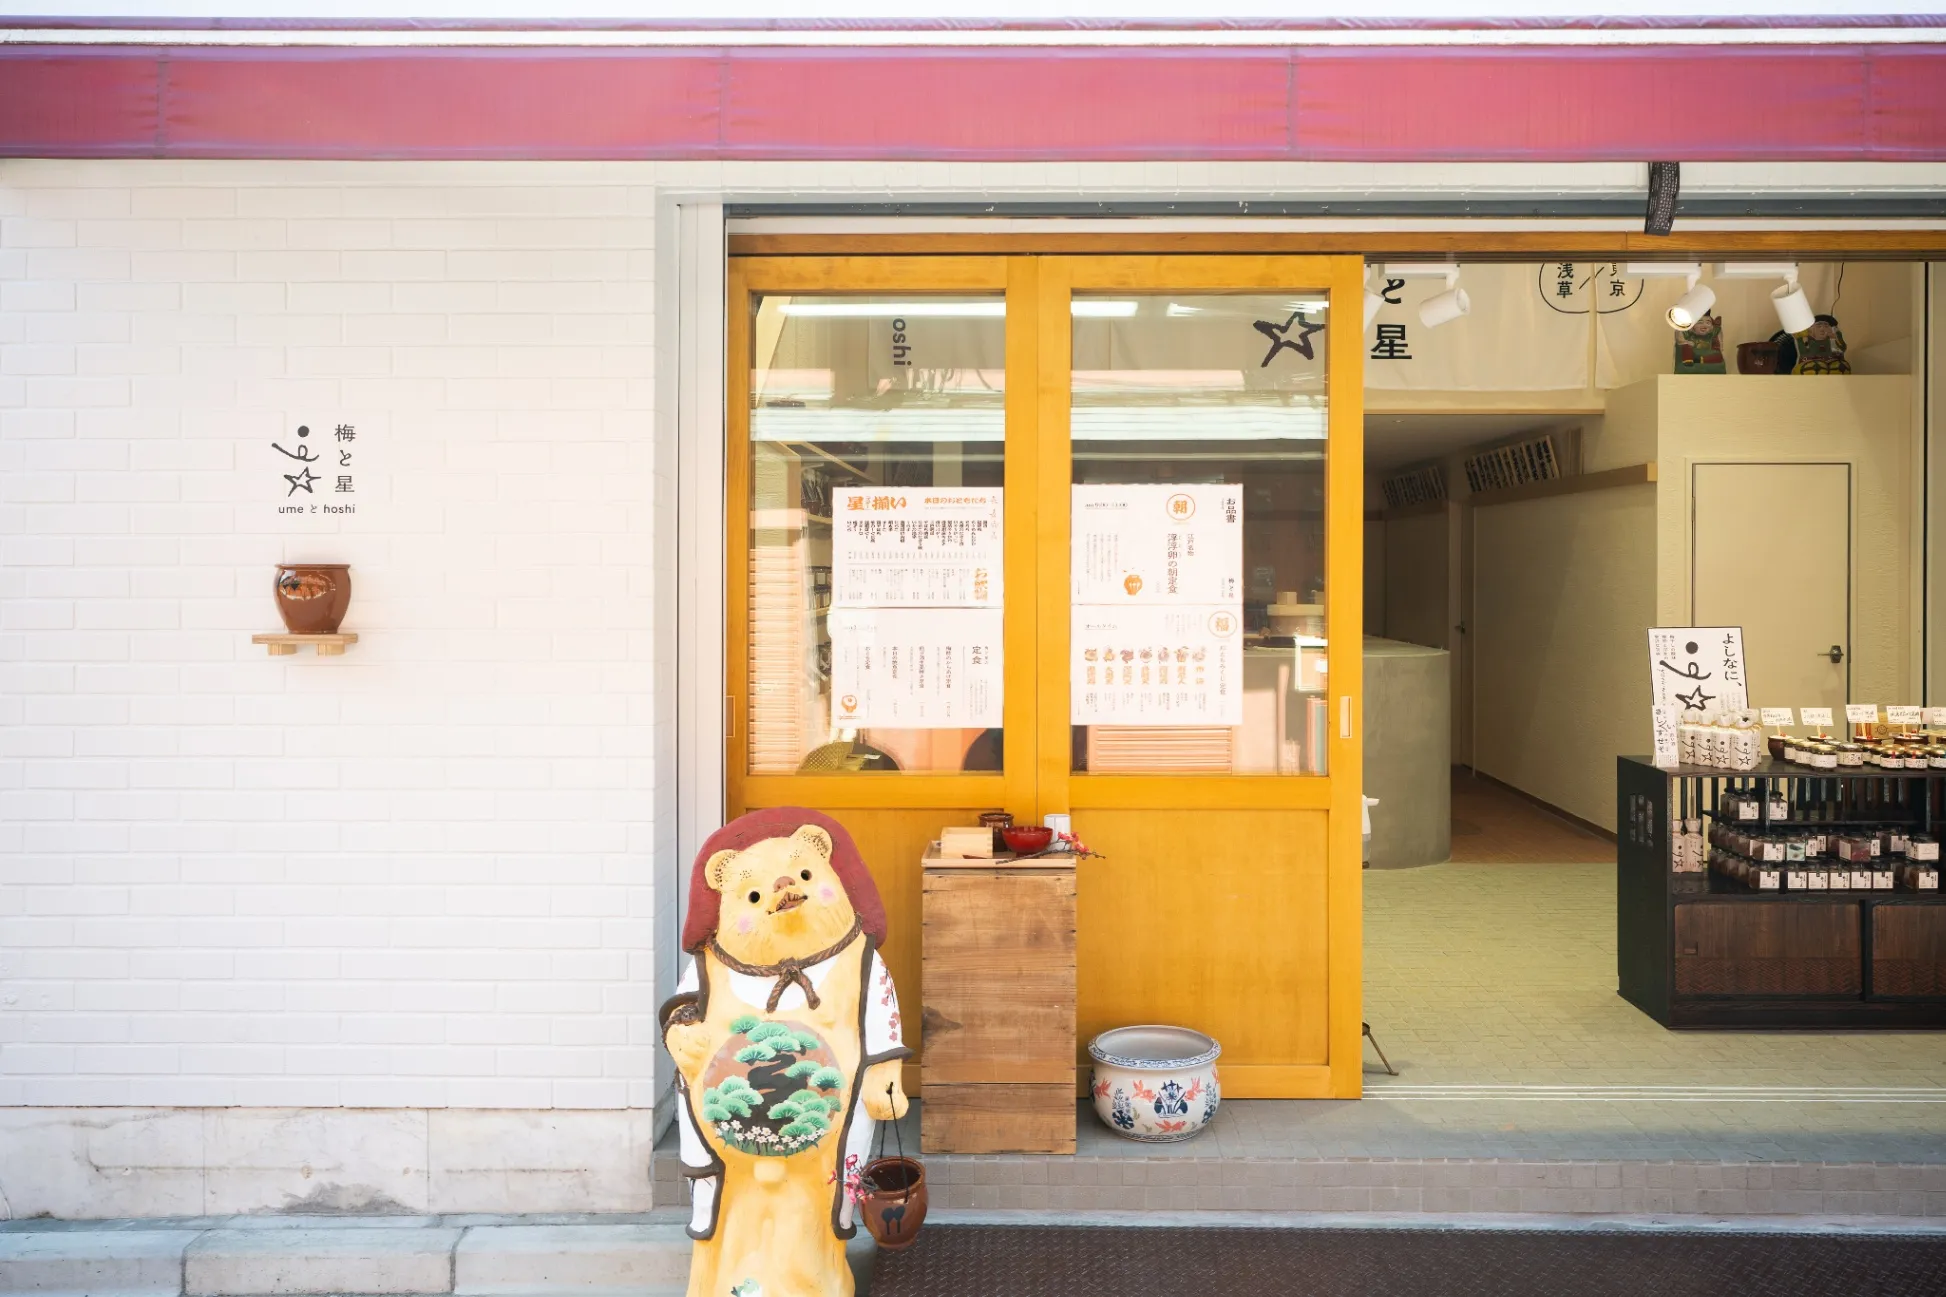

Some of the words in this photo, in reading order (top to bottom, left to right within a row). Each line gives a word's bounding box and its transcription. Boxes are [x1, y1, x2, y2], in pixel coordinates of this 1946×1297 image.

[1557, 262, 1574, 298] 浅草
[892, 315, 912, 366] oshi
[334, 423, 356, 493] 梅と星
[278, 504, 304, 514] ume
[310, 504, 318, 514] と
[323, 503, 356, 514] hoshi
[1173, 500, 1188, 514] 朝
[1226, 497, 1237, 524] お品書
[1215, 617, 1230, 632] 福
[972, 645, 982, 665] 定食
